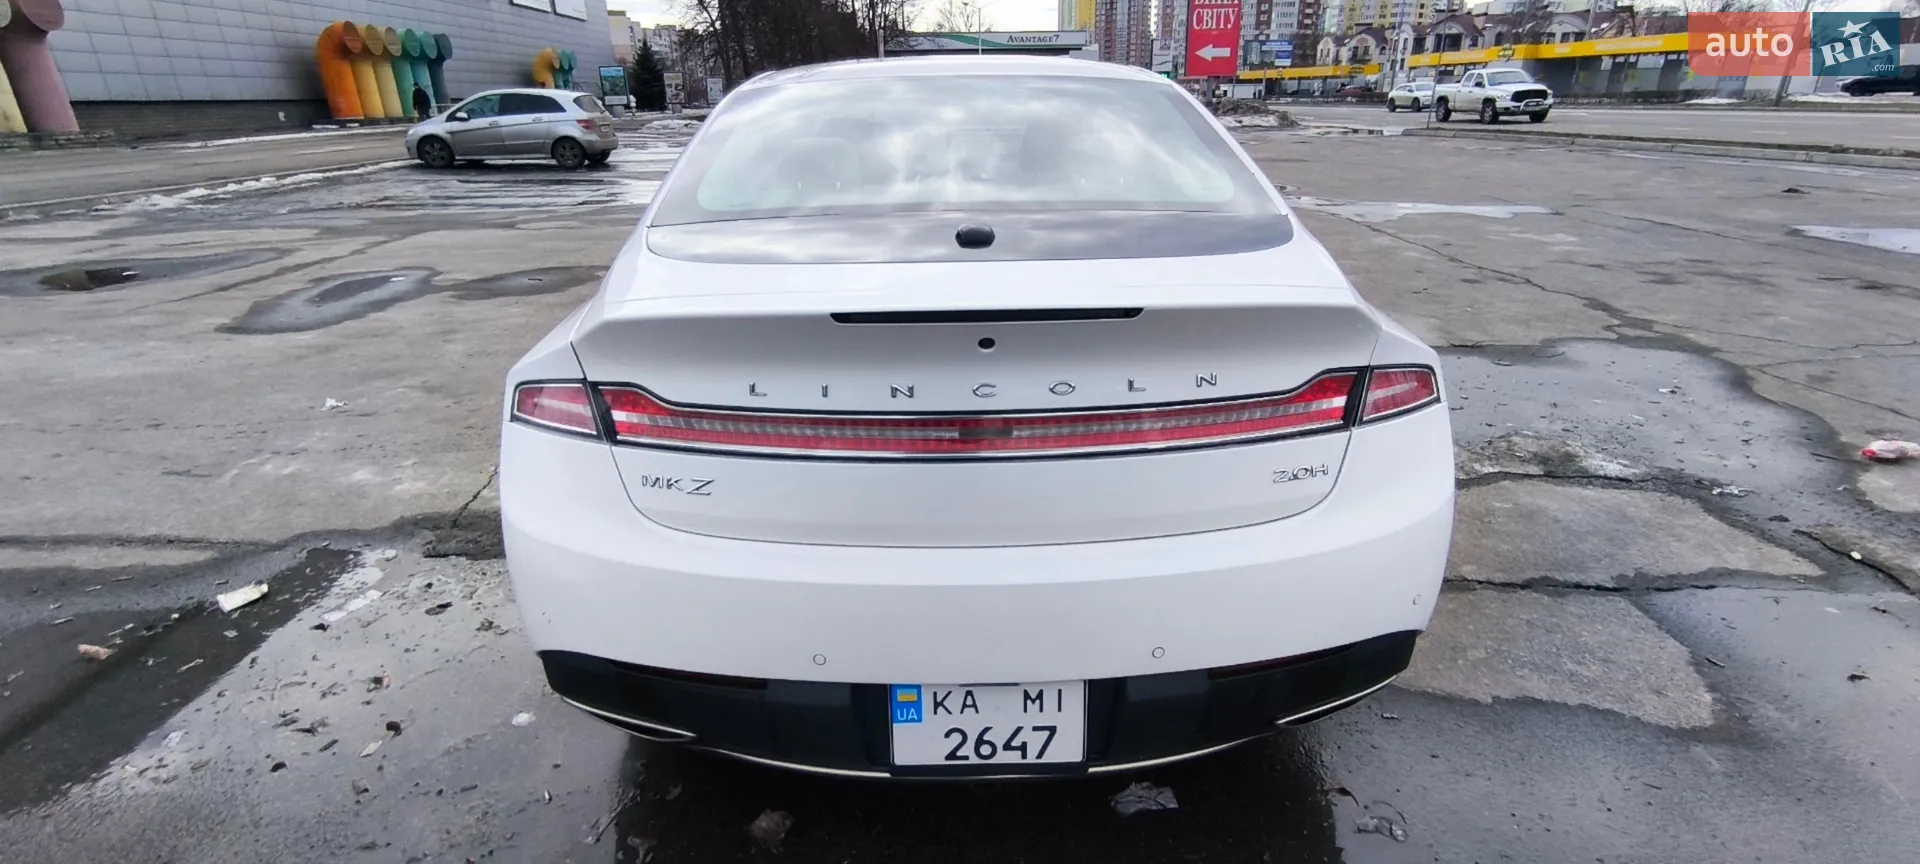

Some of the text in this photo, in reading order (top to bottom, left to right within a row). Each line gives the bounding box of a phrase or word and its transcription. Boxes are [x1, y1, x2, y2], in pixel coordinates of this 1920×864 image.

[1193, 8, 1239, 30] СВІТУ
[748, 372, 1218, 399] LINCOLN
[897, 708, 918, 720] UA
[932, 688, 1062, 715] KA MI
[943, 725, 1058, 761] 2647
